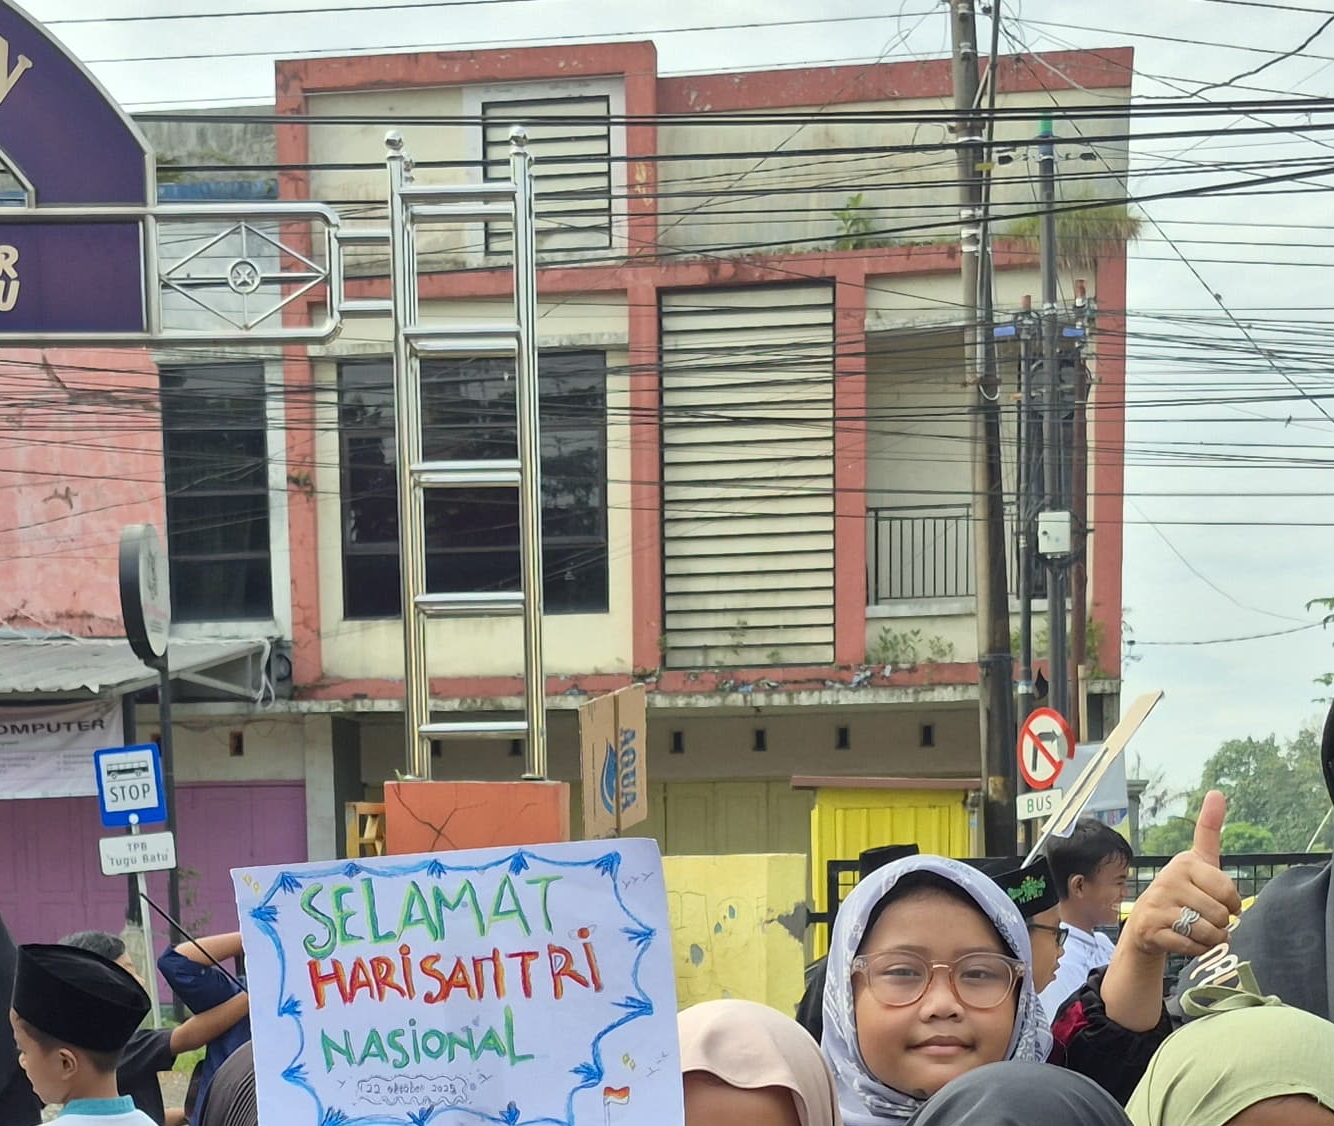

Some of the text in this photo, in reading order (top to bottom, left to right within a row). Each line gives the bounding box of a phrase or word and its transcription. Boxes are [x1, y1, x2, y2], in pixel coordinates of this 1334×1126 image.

[109, 783, 151, 803] STOP
[619, 727, 637, 814] AQUA
[1026, 794, 1053, 814] BUS
[299, 873, 564, 960] SELAMAT
